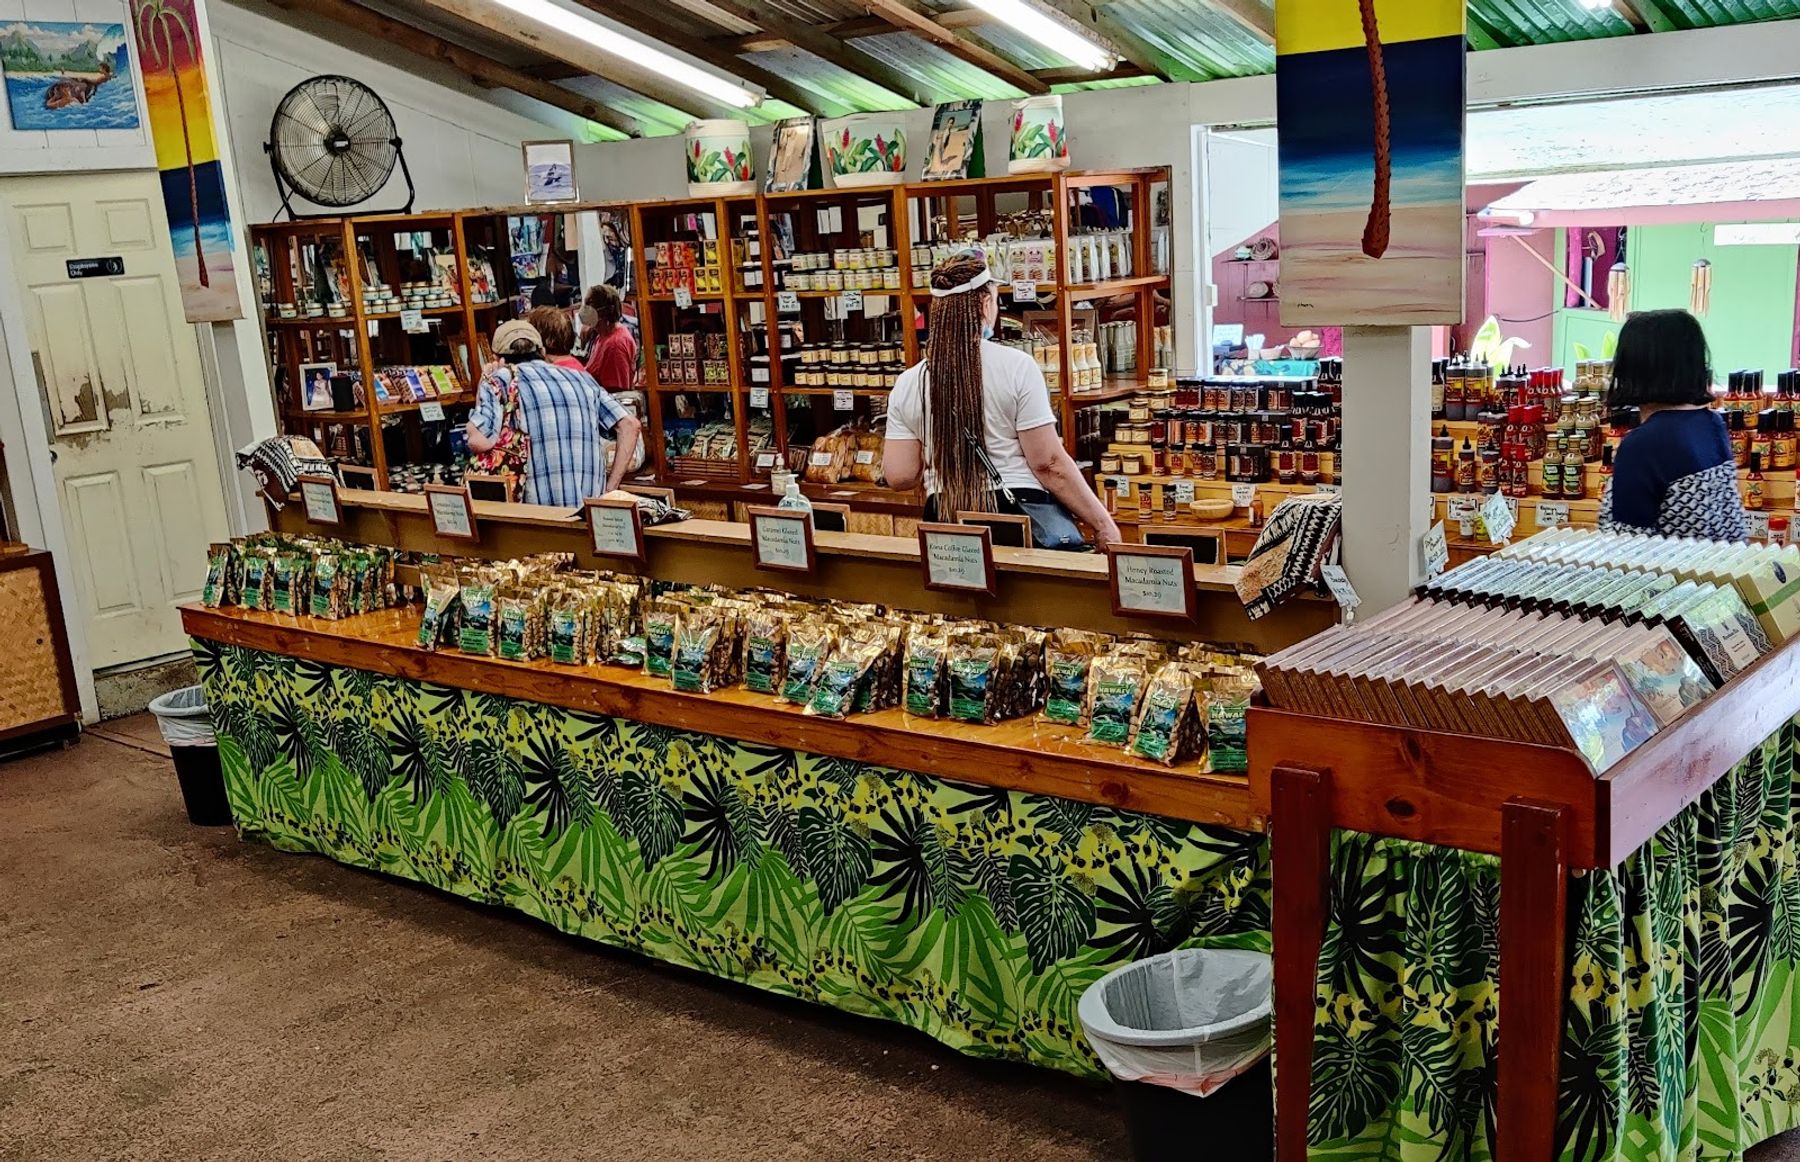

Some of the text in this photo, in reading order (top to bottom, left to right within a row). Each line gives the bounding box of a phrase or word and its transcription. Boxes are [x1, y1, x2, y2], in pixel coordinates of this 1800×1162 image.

[933, 553, 963, 562] Macadamia
[1127, 565, 1174, 575] Honey Roasted
[1124, 576, 1178, 587] Macadamia Nuts
